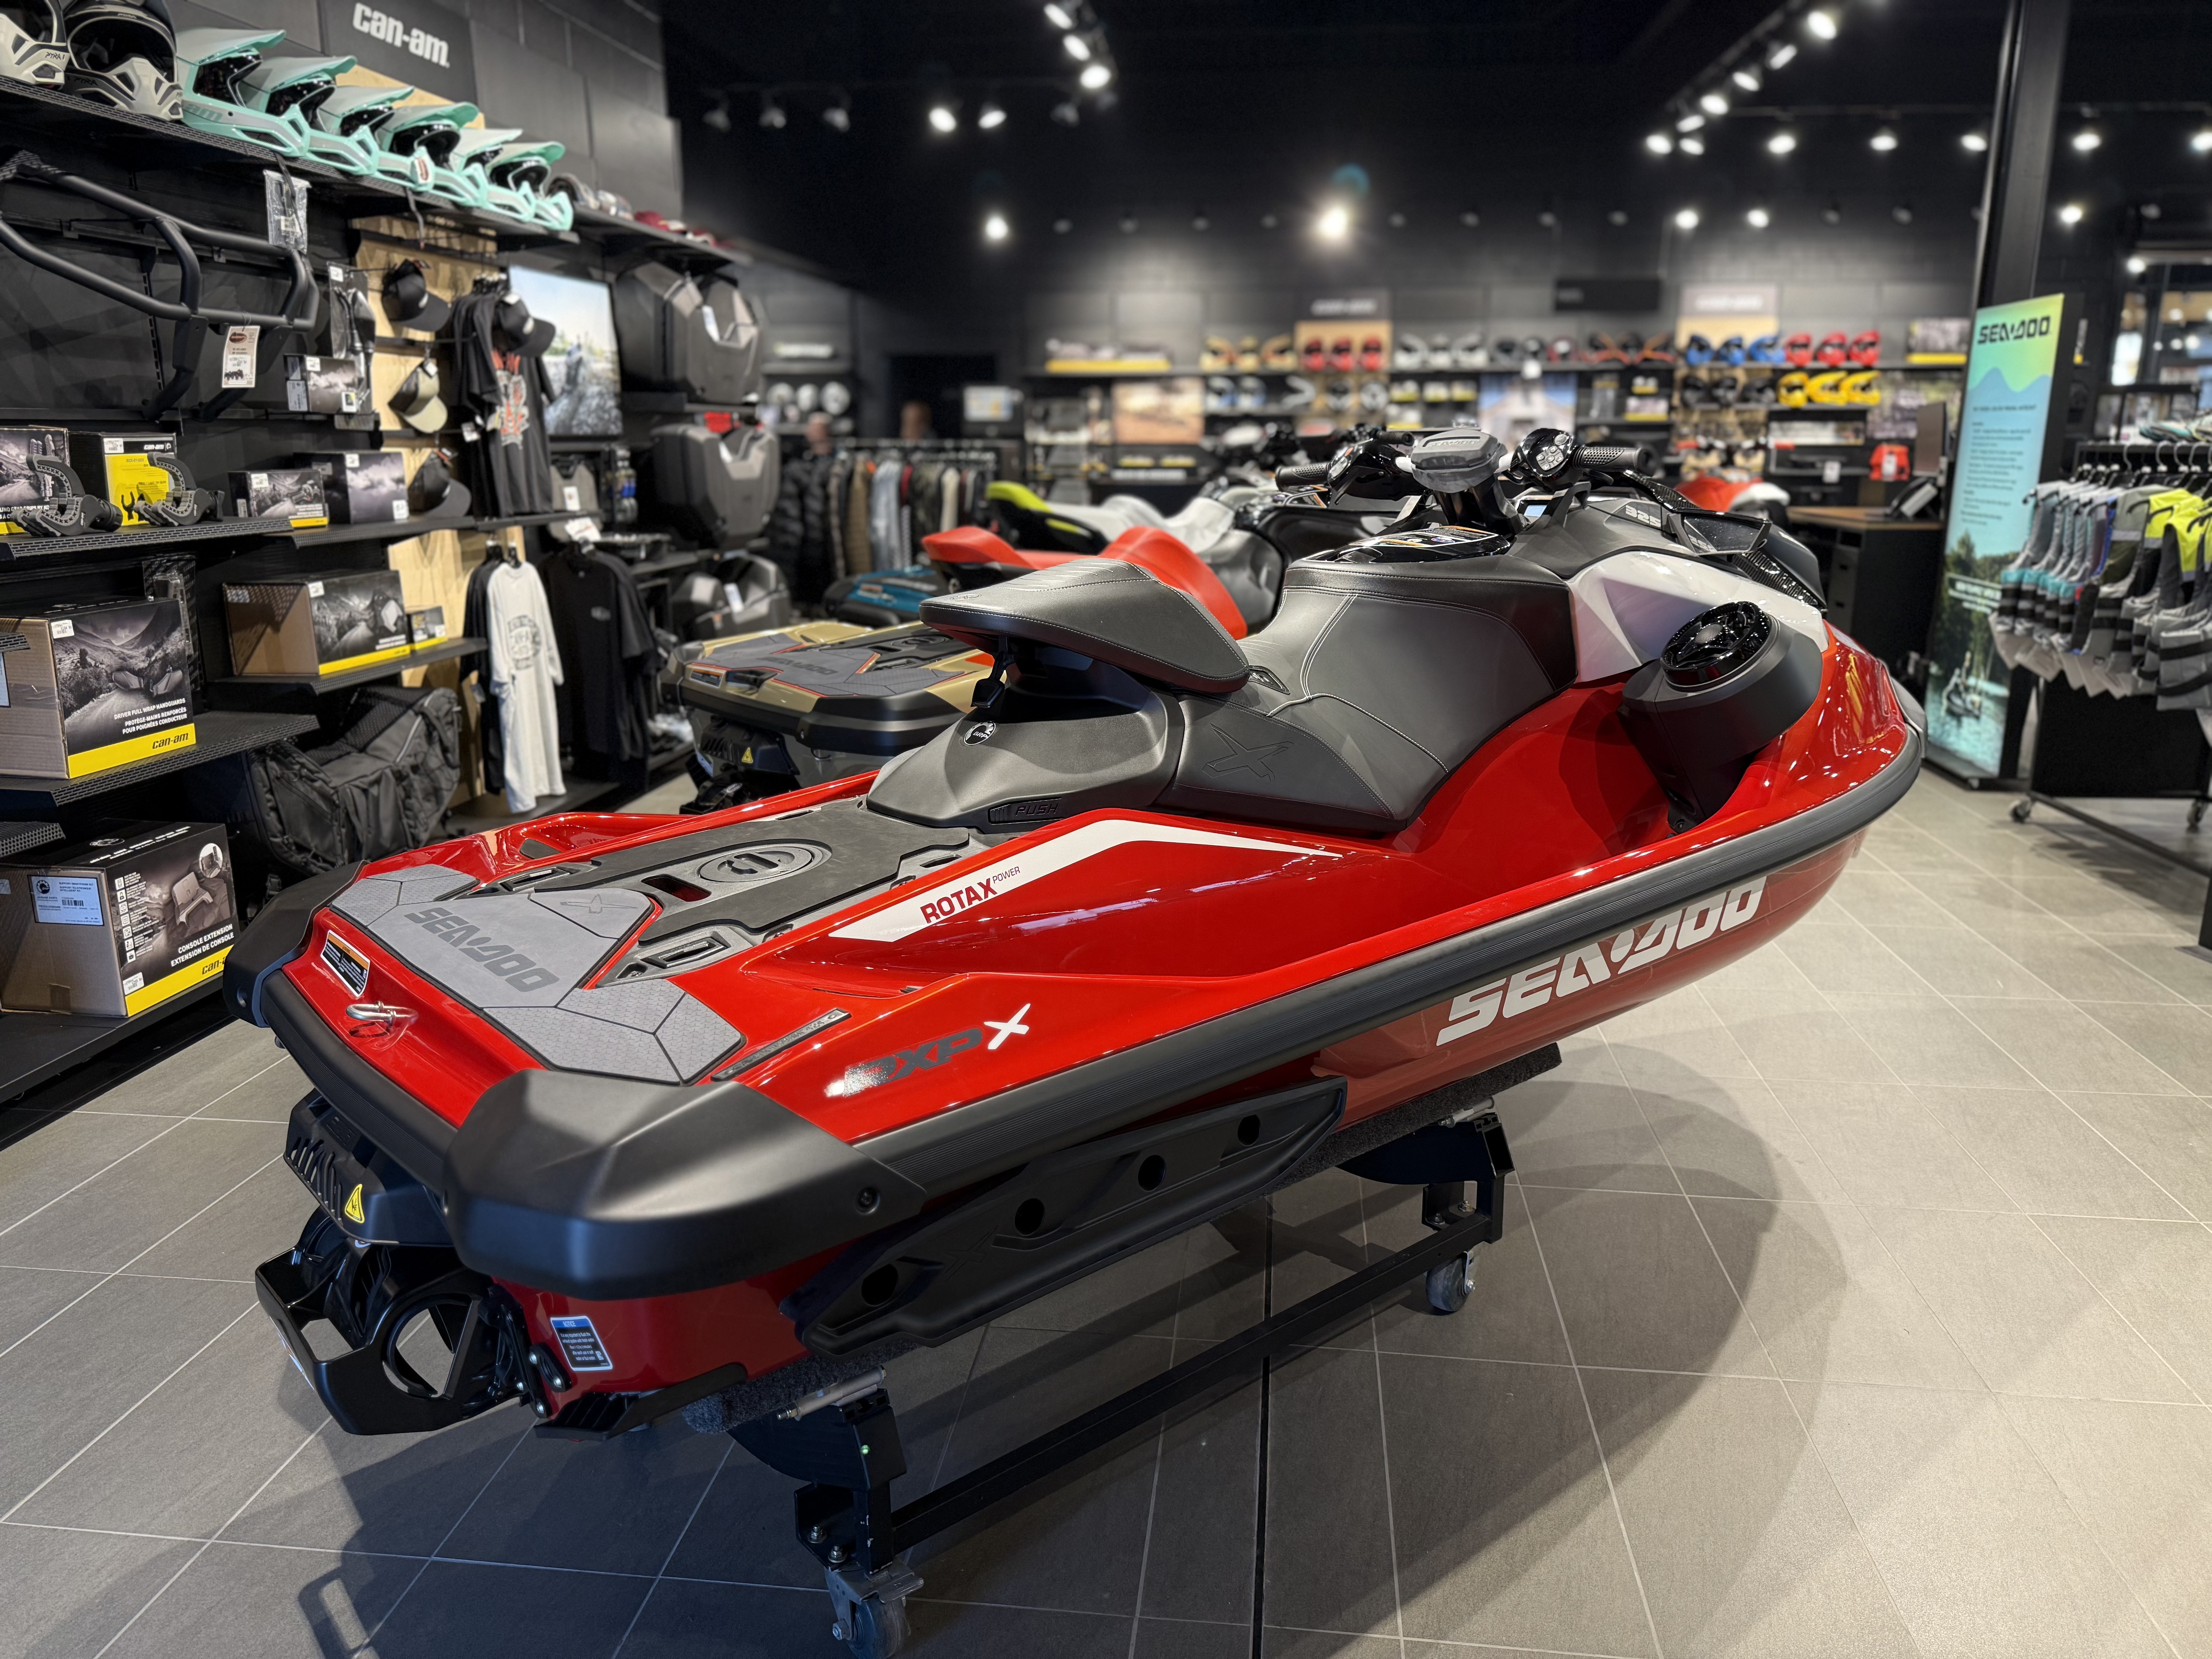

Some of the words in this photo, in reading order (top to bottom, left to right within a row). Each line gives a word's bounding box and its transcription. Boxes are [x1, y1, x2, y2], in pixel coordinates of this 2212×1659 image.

[353, 3, 449, 67] can-am
[1625, 505, 1661, 527] 325
[114, 711, 131, 720] DRIVER
[156, 698, 185, 710] HANDGUARDS
[125, 714, 161, 726] PROTÈGE-MAINS
[161, 707, 187, 718] RENFORCÉS
[136, 721, 158, 730] POIGNÉES
[159, 713, 187, 725] CONDUCTEUR
[152, 733, 189, 749] can-am
[1015, 804, 1058, 817] PUSH
[920, 878, 998, 924] ROTAX
[993, 866, 1020, 884] POWER
[171, 947, 202, 967] EXTENSION
[202, 944, 210, 952] DE
[210, 932, 235, 948] CONSOLE
[178, 937, 203, 954] CONSOLE
[204, 924, 233, 942] EXTENSION
[202, 957, 227, 975] can-a
